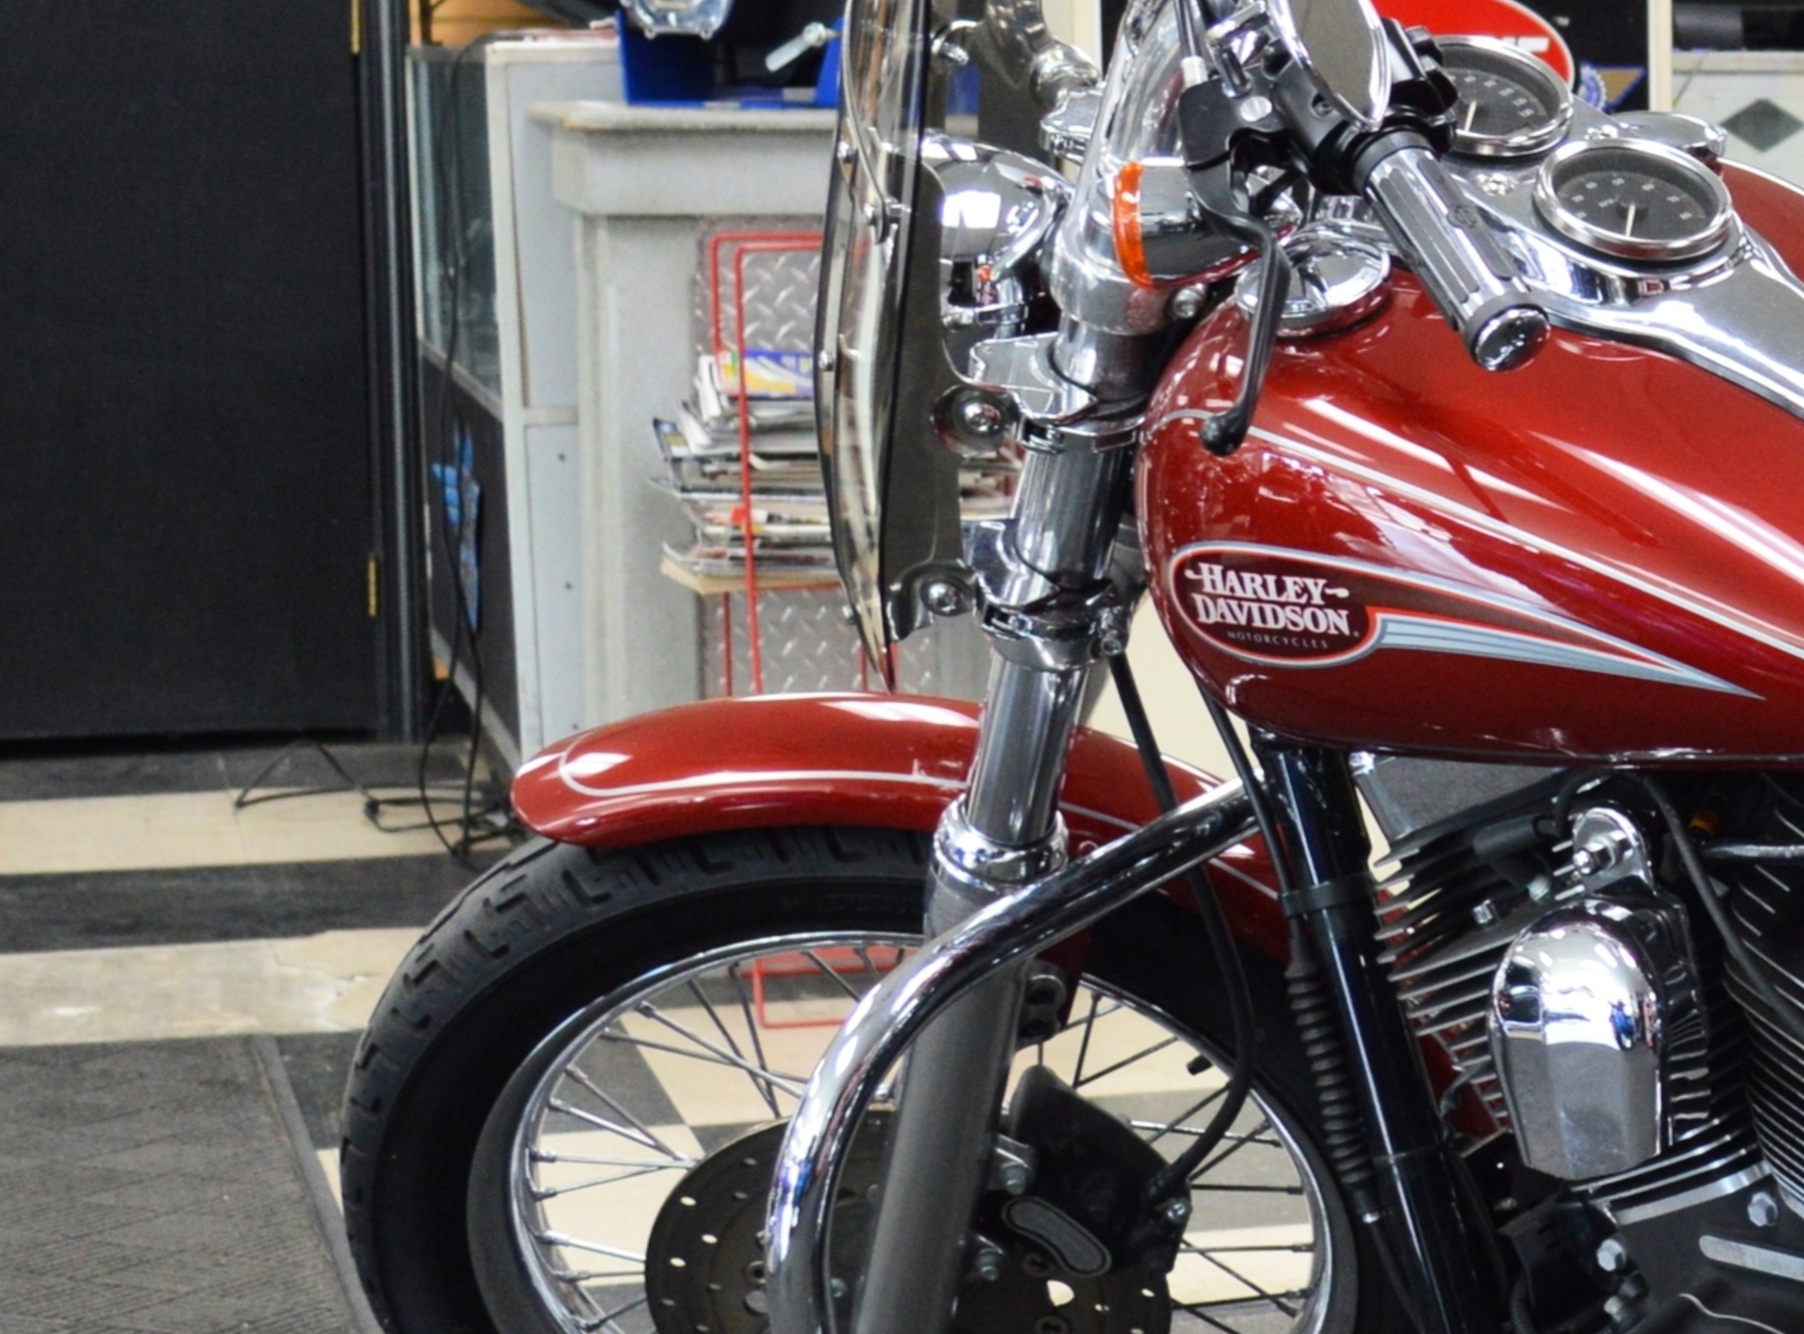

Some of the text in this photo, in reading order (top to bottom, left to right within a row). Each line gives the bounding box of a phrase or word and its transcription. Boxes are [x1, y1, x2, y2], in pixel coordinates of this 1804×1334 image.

[1197, 562, 1328, 605] HARLEY
[1192, 593, 1351, 637] DAVIDSON
[1226, 630, 1329, 650] MOTORCYCLES
